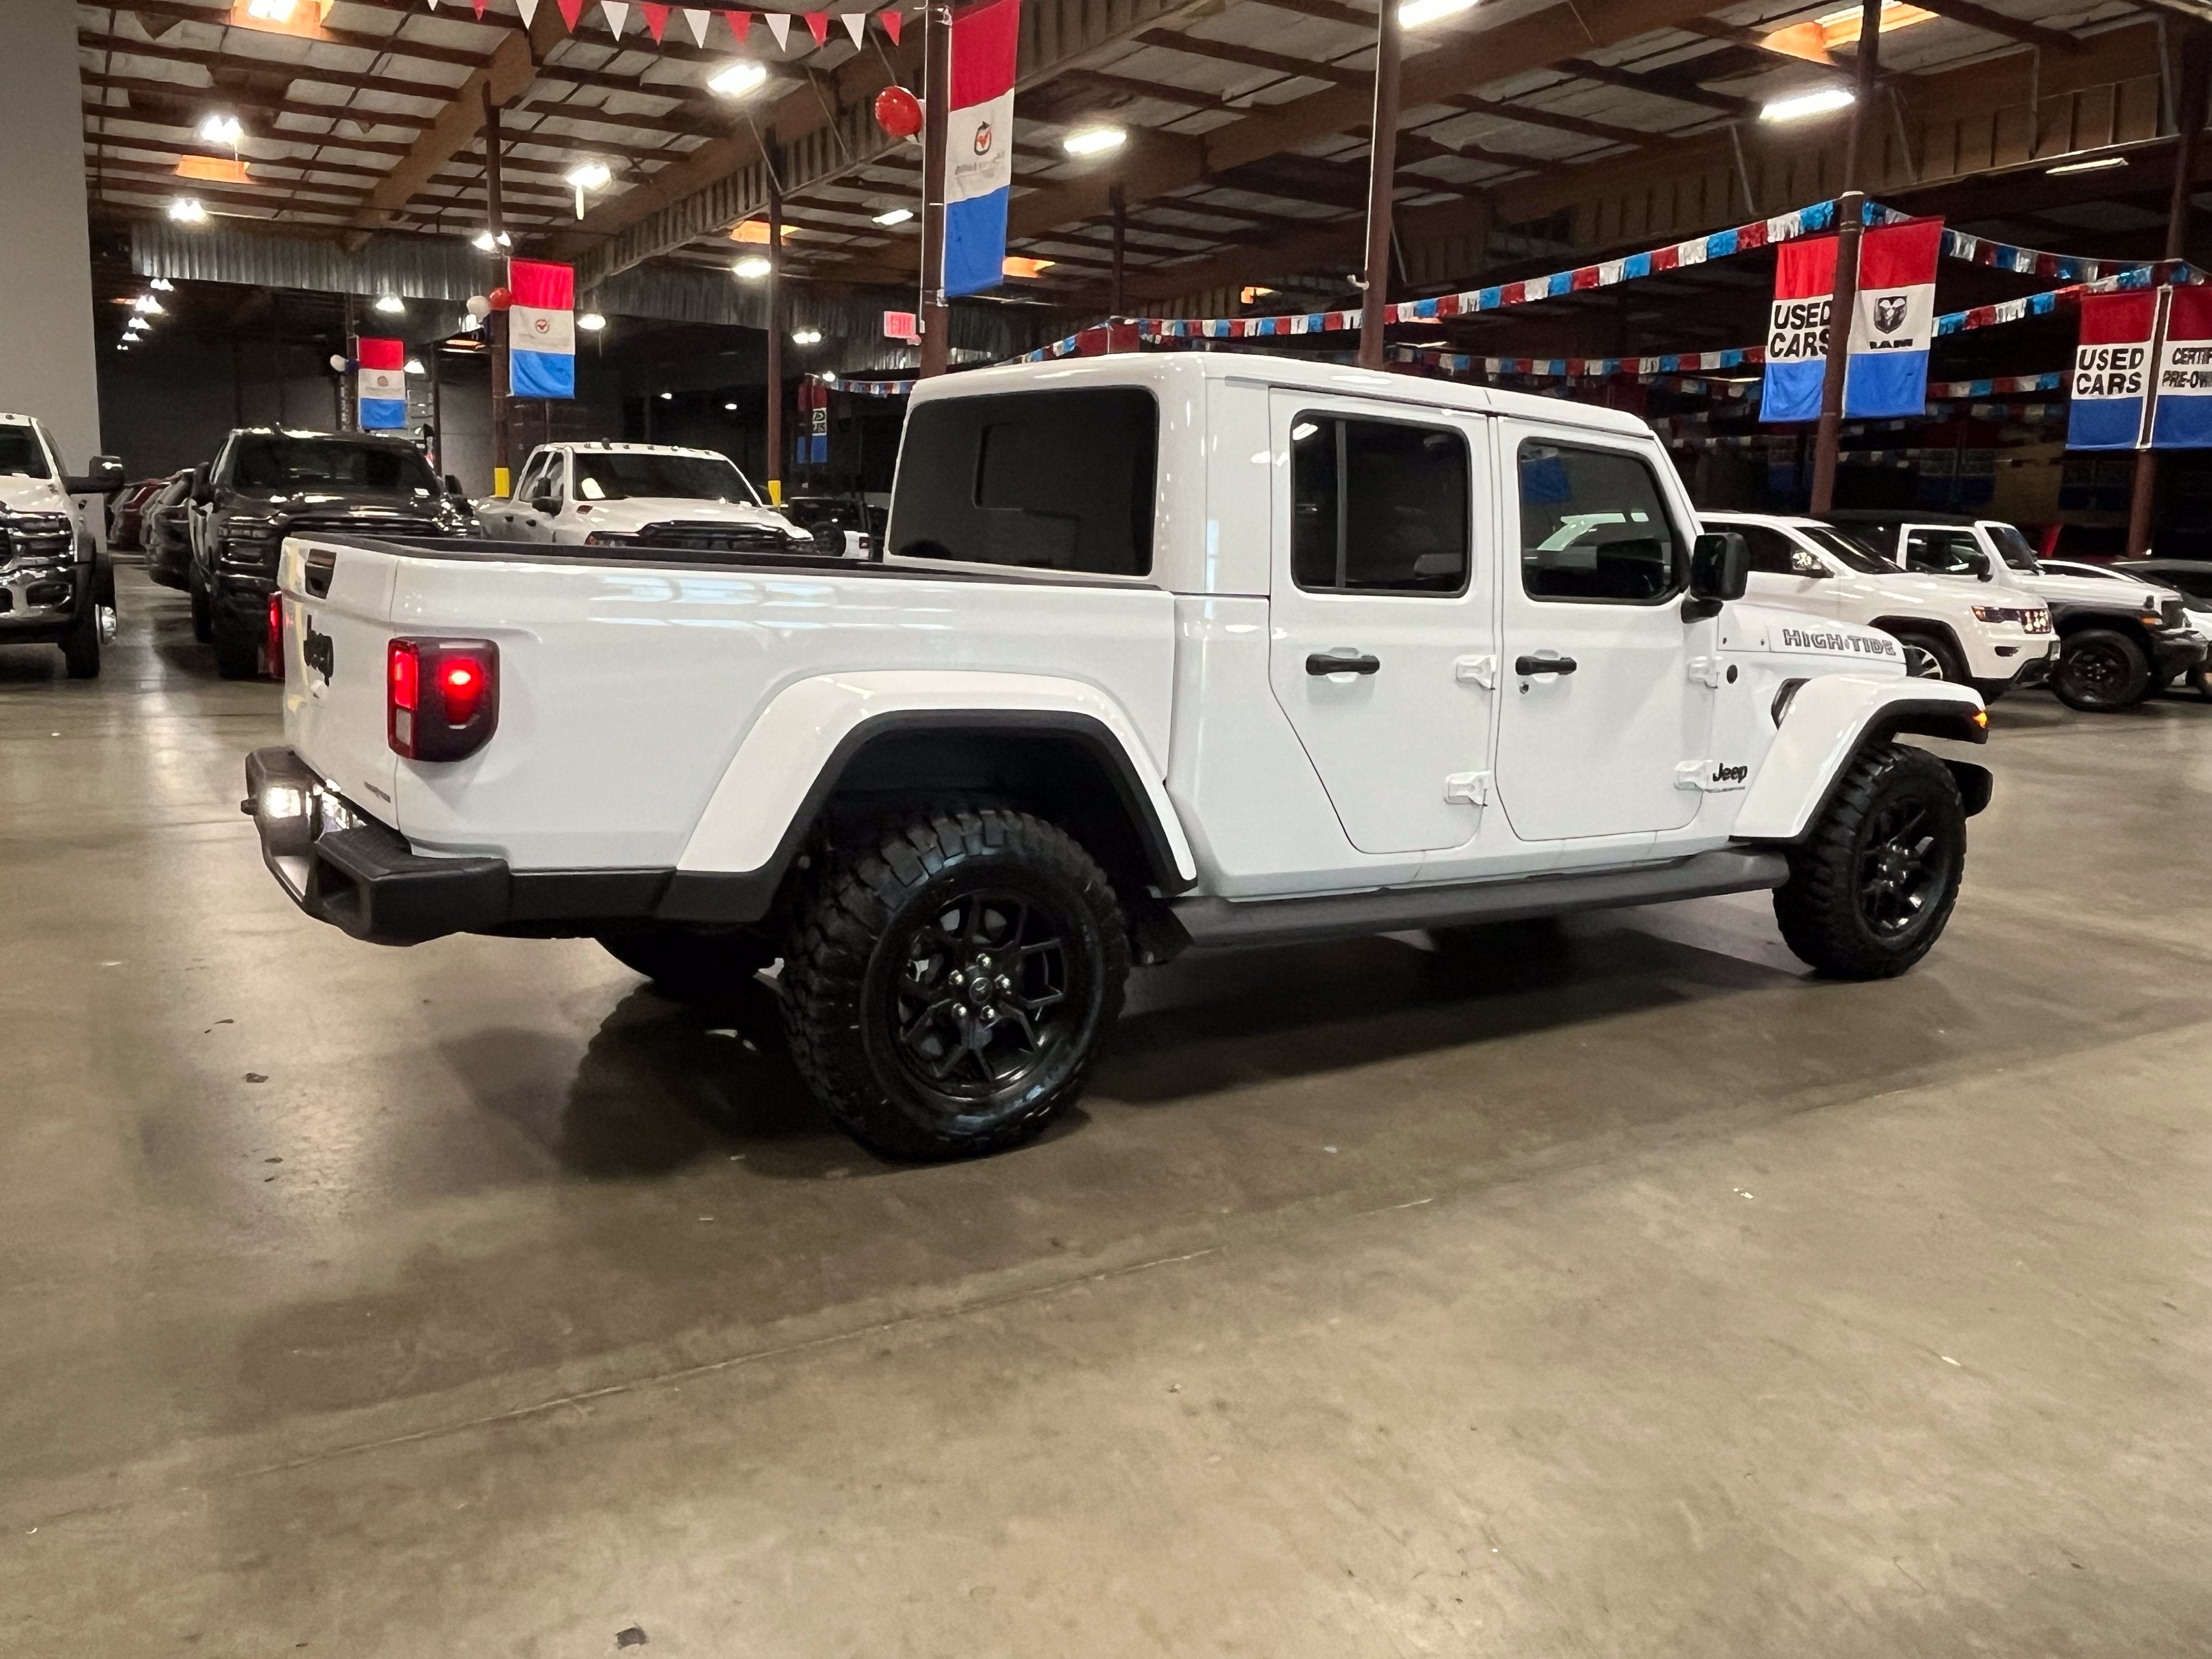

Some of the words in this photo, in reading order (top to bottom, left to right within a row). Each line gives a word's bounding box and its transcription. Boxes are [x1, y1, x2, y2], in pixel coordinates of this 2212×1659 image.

[1774, 301, 1830, 329] USED
[1770, 329, 1829, 357] CARS
[2079, 348, 2144, 371] USED
[2076, 372, 2142, 395] CARS
[1713, 763, 1747, 783] Jeep
